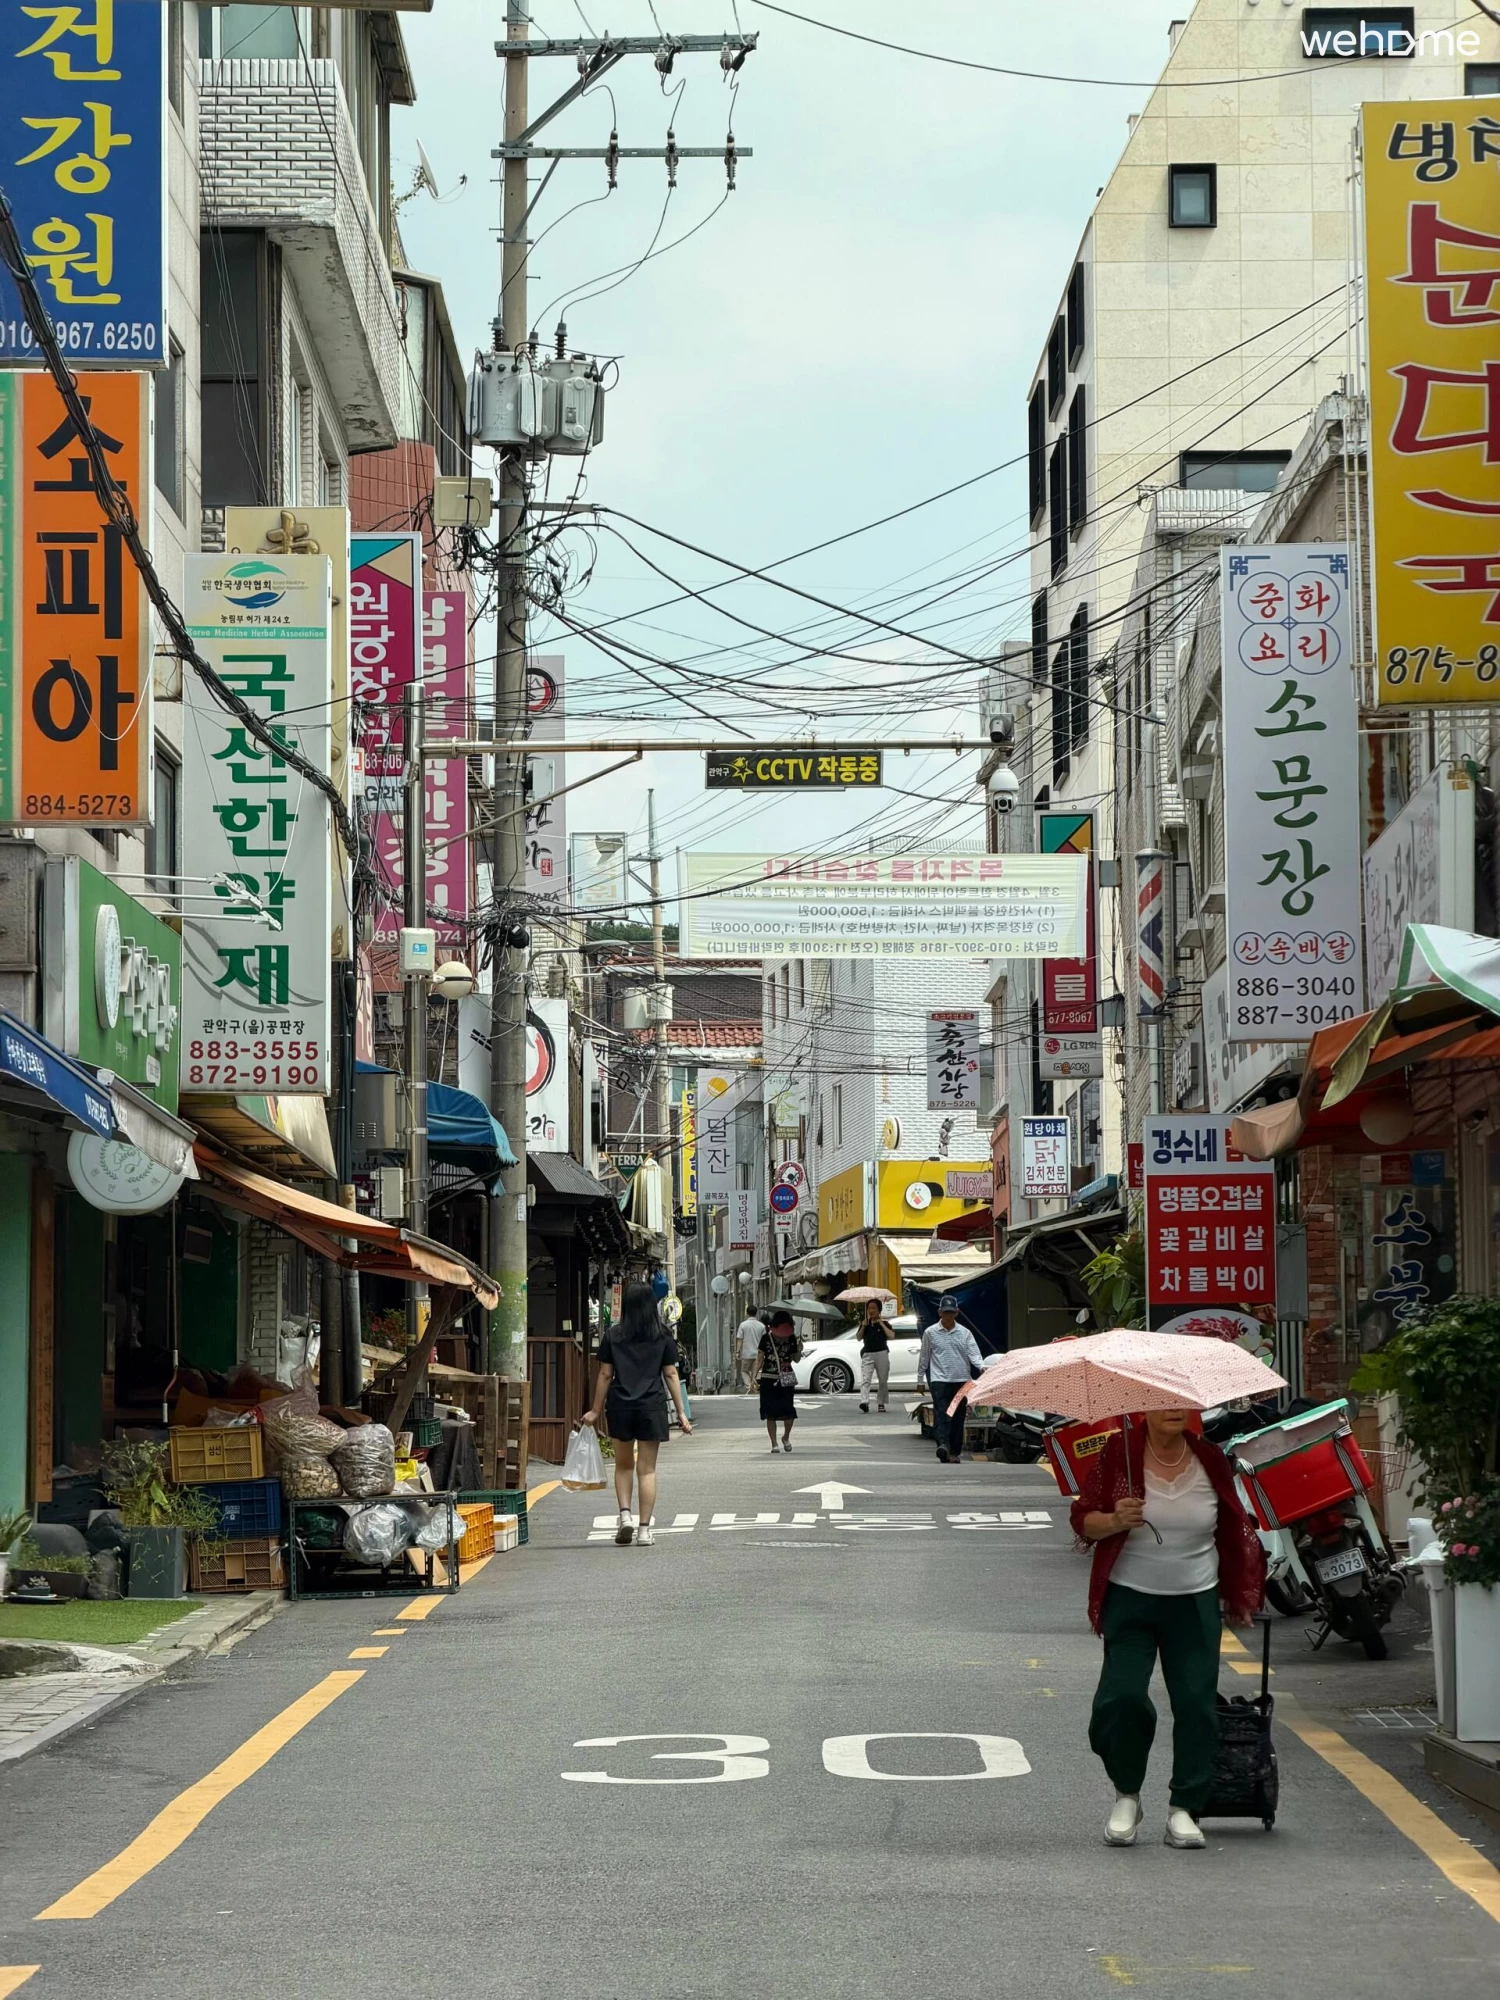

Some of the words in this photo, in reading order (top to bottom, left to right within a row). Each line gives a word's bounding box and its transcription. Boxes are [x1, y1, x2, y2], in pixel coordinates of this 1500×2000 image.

[14, 0, 132, 305] 건강원
[214, 580, 272, 590] 한국생약협회
[215, 628, 248, 638] Medicine
[252, 628, 276, 638] Herbal
[281, 629, 324, 638] Association
[708, 767, 730, 777] 관악구
[756, 758, 814, 781] CCTV
[818, 756, 879, 782] 작동중
[25, 797, 131, 816] 884-5273
[1255, 680, 1330, 916] 소문장
[211, 655, 298, 1004] 국산한약재
[1240, 936, 1349, 961] 신속배달
[1237, 977, 1355, 997] 886-3040
[1237, 1005, 1354, 1025] 887-3040
[202, 1019, 305, 1035] 관악구(을)공판장
[189, 1041, 319, 1060] 883-3555
[189, 1066, 319, 1085] 872-9190
[1024, 1122, 1066, 1136] 원당야채
[1034, 1139, 1060, 1164] 닭
[1152, 1128, 1218, 1164] 경수네
[610, 1154, 644, 1167] TERRA
[949, 1172, 981, 1196] JUICY
[1026, 1166, 1066, 1182] 김치전문
[1025, 1184, 1067, 1195] 886-1351
[1158, 1185, 1264, 1213] 명품오겹살
[737, 1193, 749, 1240] 명당맛집
[1159, 1225, 1265, 1253] 꽃갈비살
[1159, 1265, 1265, 1293] 차돌박이
[1076, 1435, 1107, 1453] 초보운전
[1330, 1558, 1362, 1577] 3073
[561, 1733, 1032, 1785] 30
